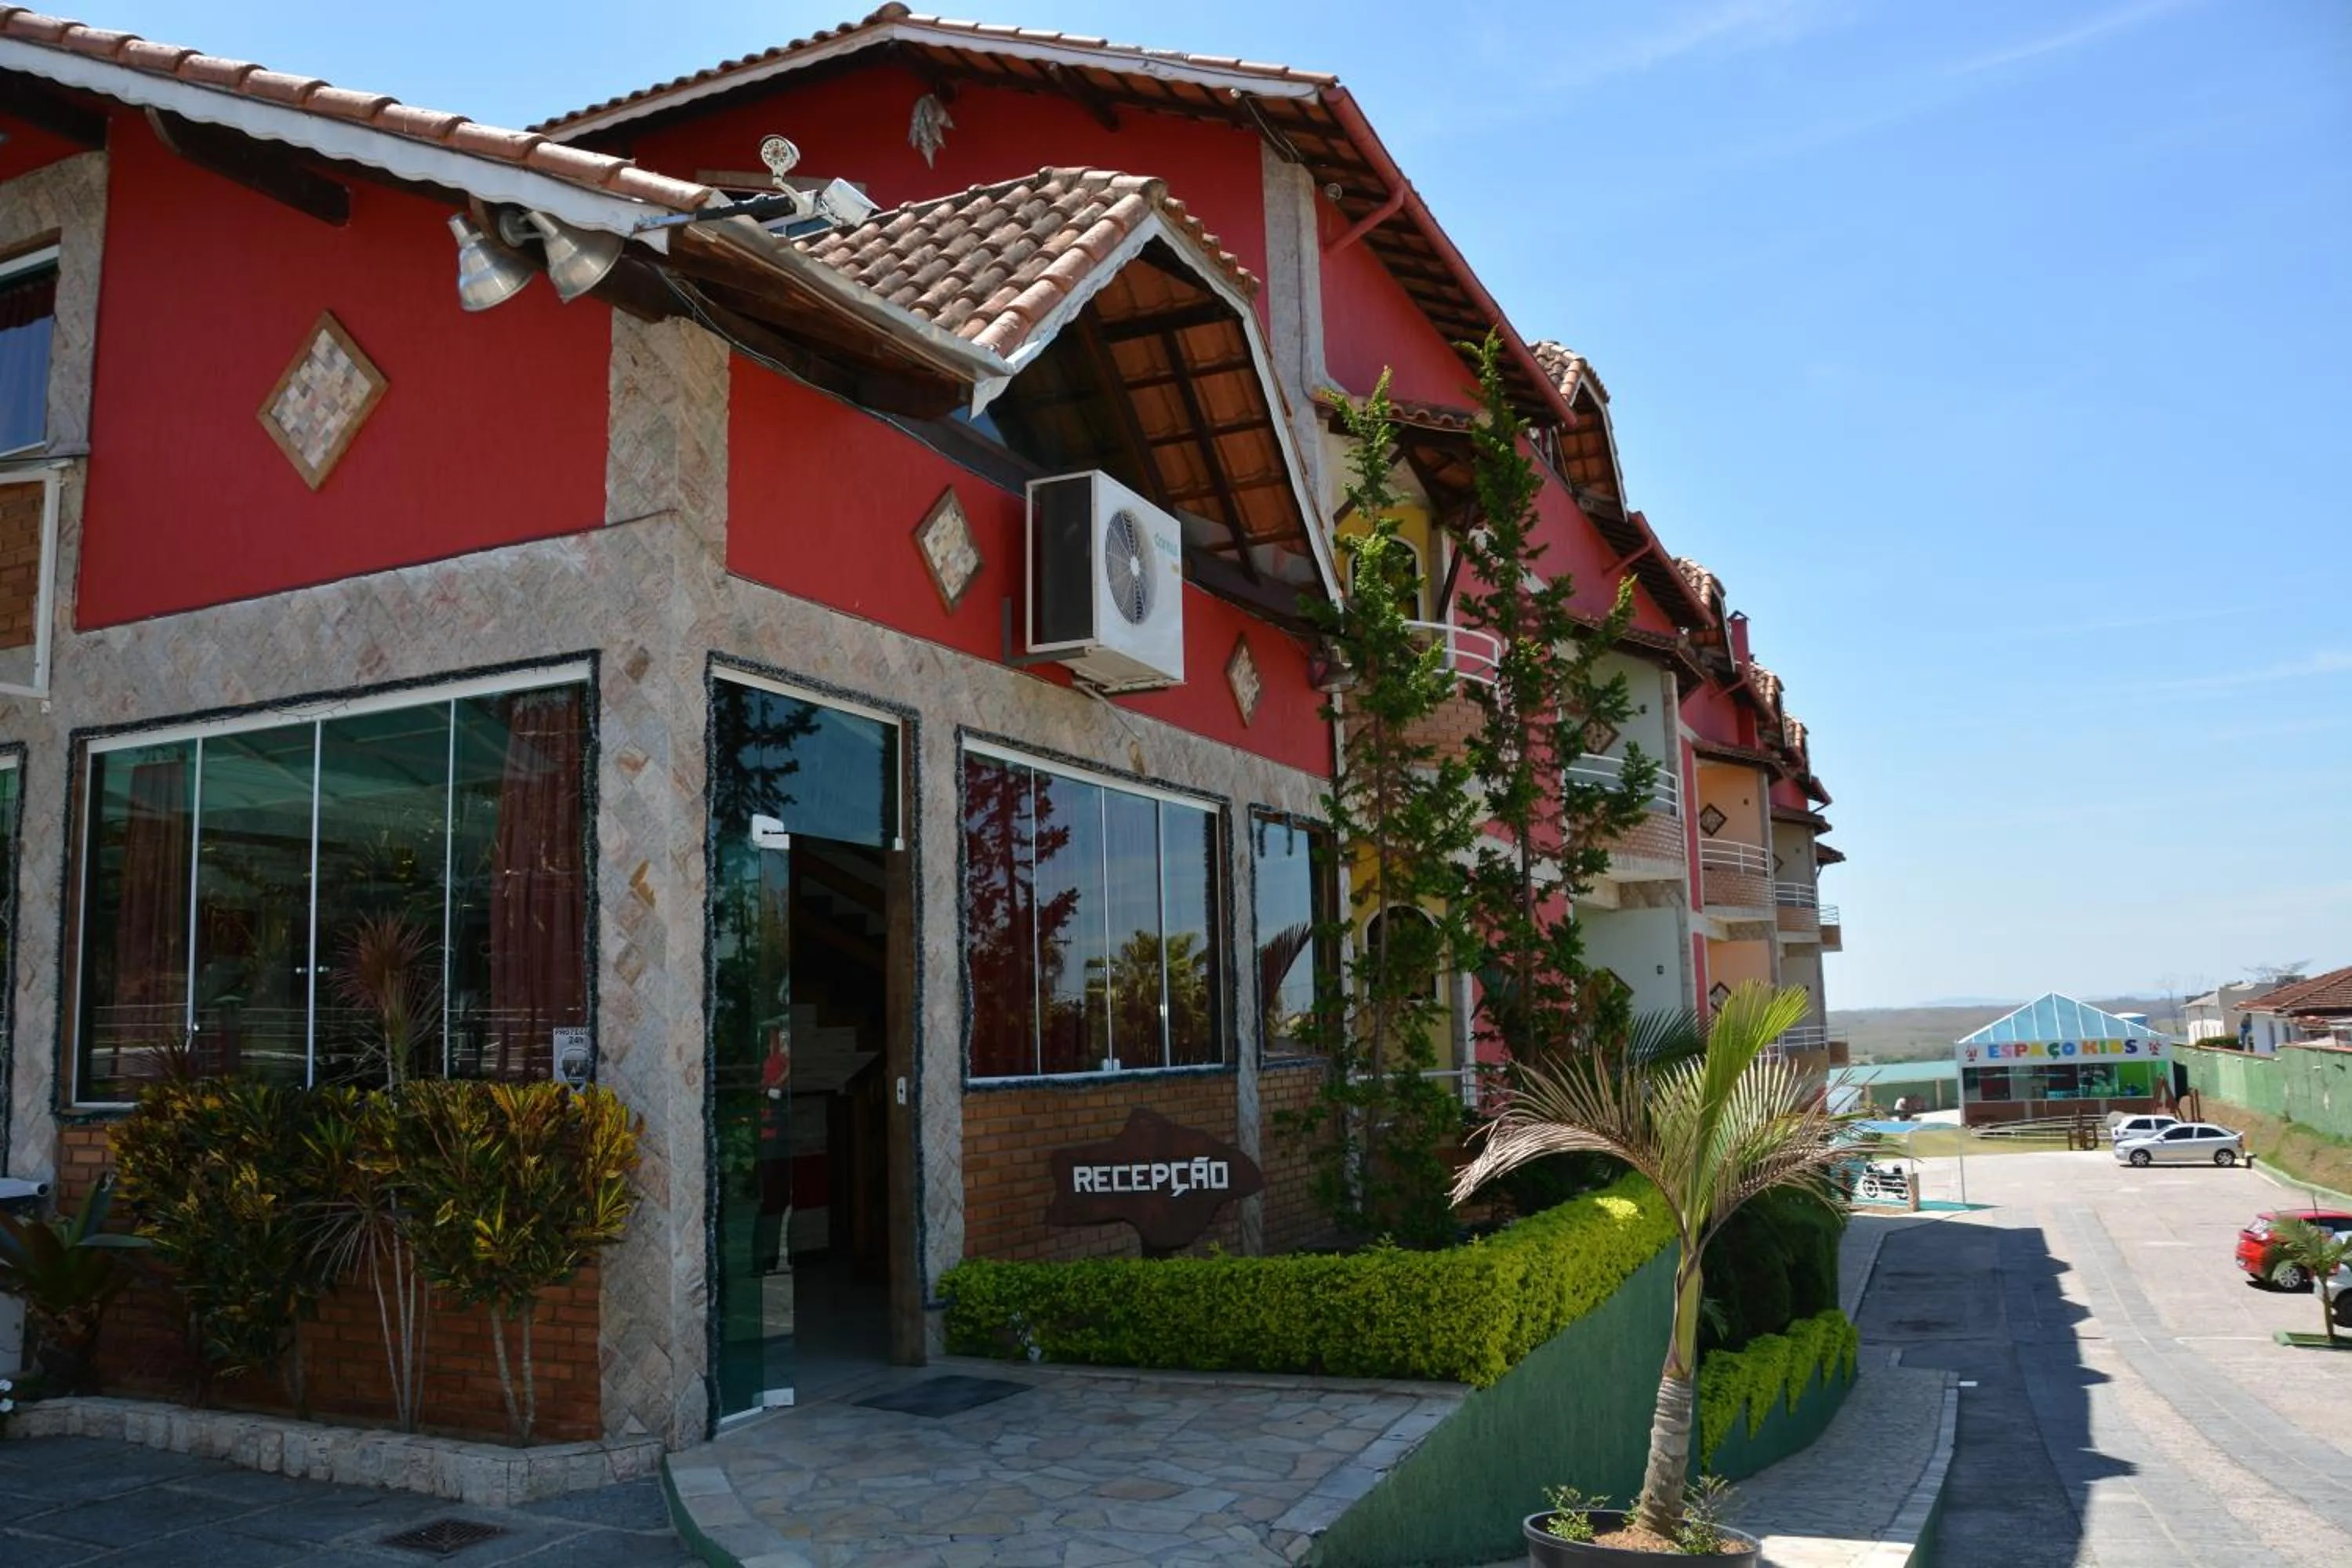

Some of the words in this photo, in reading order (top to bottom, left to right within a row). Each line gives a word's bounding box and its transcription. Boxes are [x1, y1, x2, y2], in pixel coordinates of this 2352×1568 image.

[1987, 1042, 2077, 1061] ESPAÇO
[2082, 1039, 2139, 1055] KIDS
[1073, 1156, 1229, 1197] RECEPÇÃO
